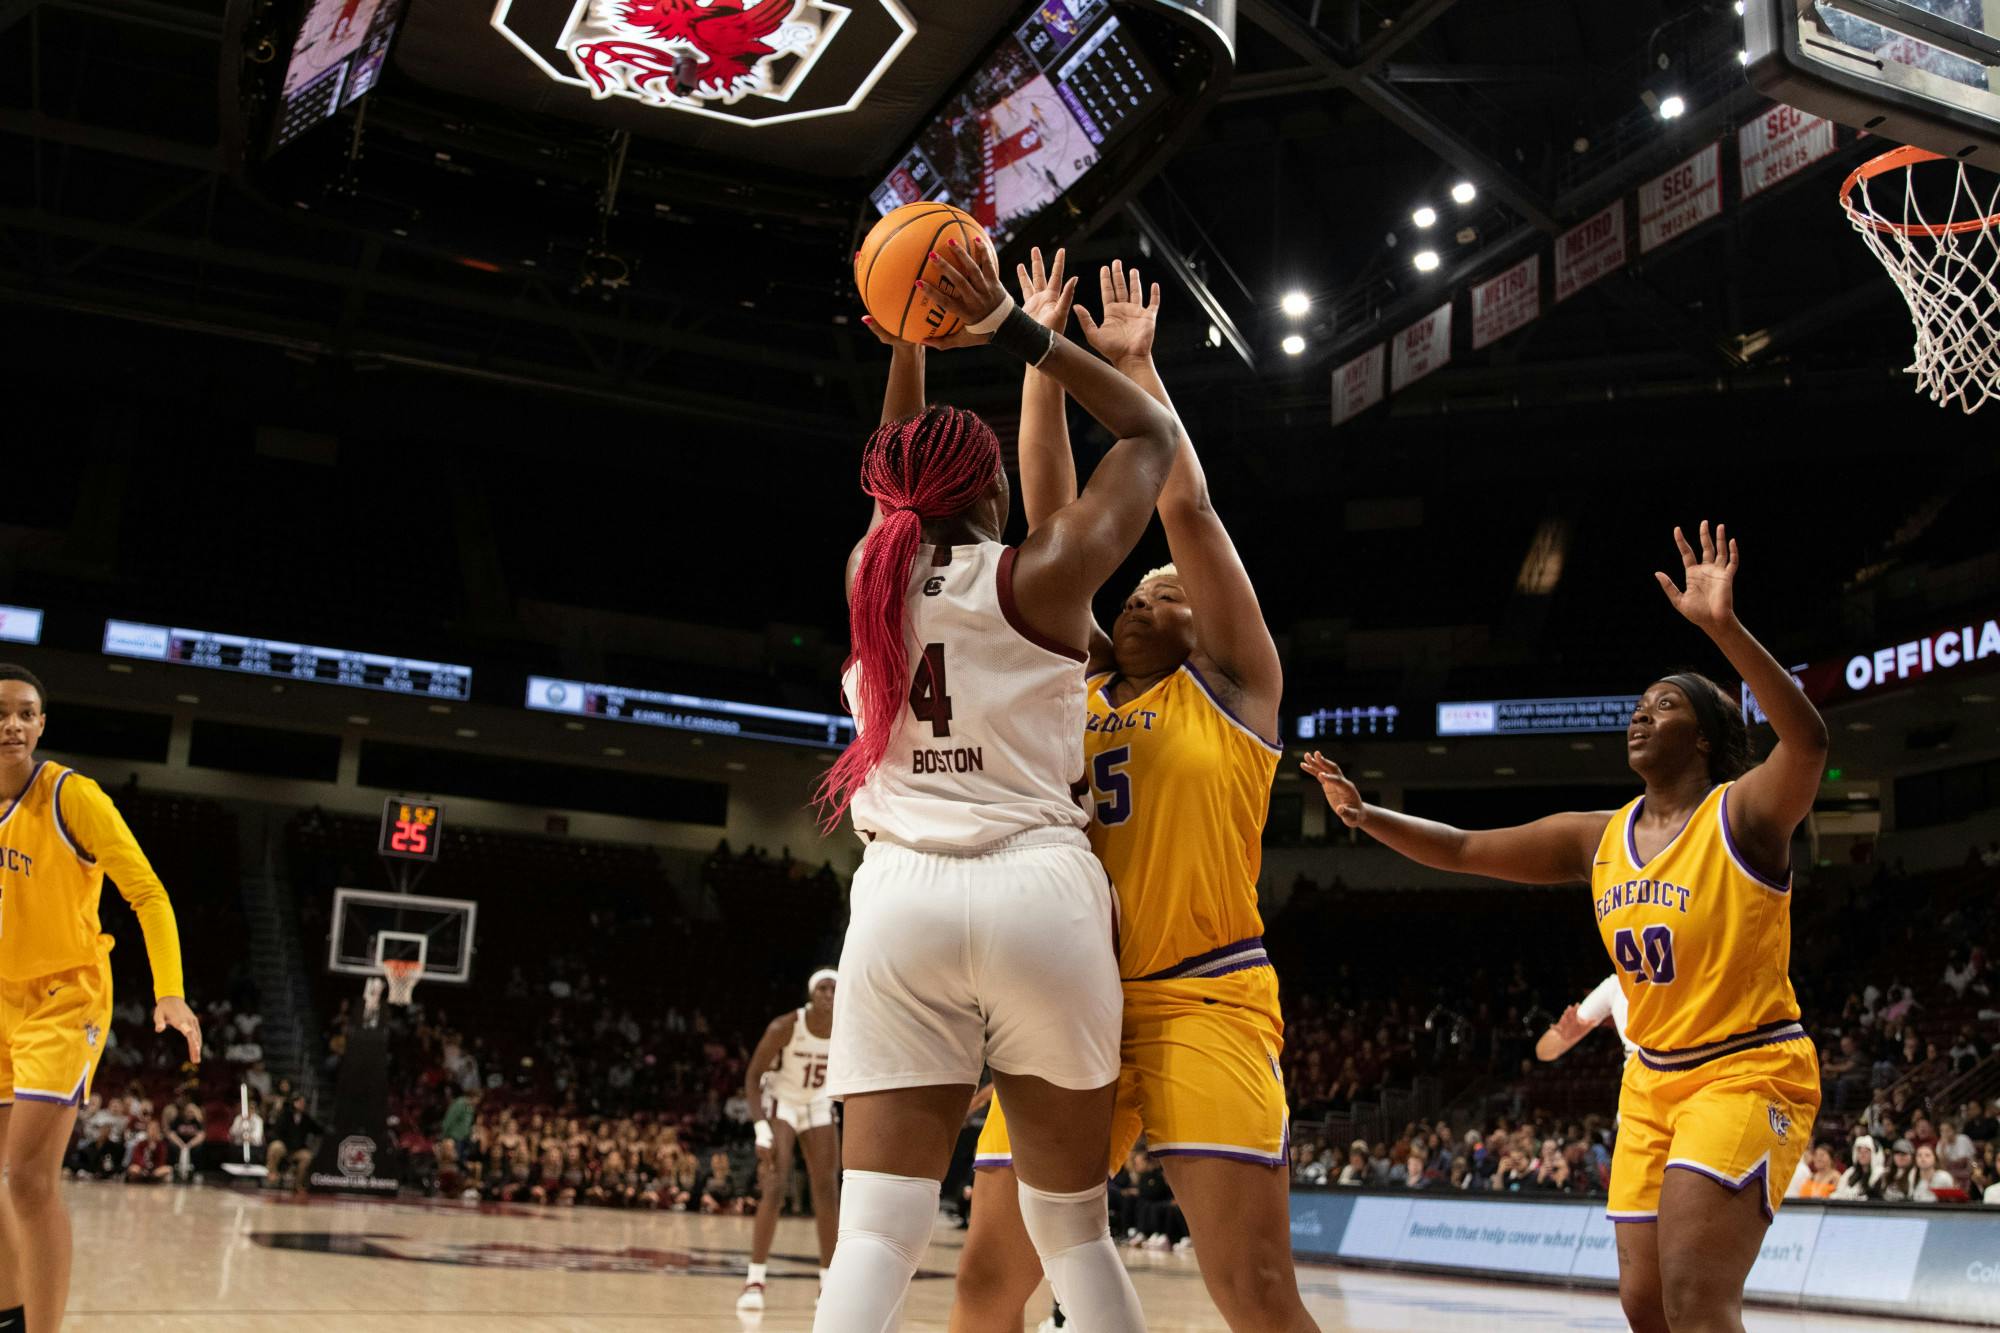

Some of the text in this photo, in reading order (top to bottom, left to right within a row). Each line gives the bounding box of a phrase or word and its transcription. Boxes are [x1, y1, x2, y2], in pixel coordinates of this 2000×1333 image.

[1662, 165, 1693, 201] SEC
[1566, 211, 1613, 259] METRO
[909, 643, 952, 738] 4
[912, 746, 984, 775] BOSTON
[391, 820, 427, 853] 25
[1596, 879, 1691, 923] BENEDICT
[1614, 923, 1676, 986] 40
[803, 1062, 828, 1088] 15
[1409, 1221, 1803, 1262] Benefits that help cover what your esn't
[1966, 1260, 2000, 1282] Col
